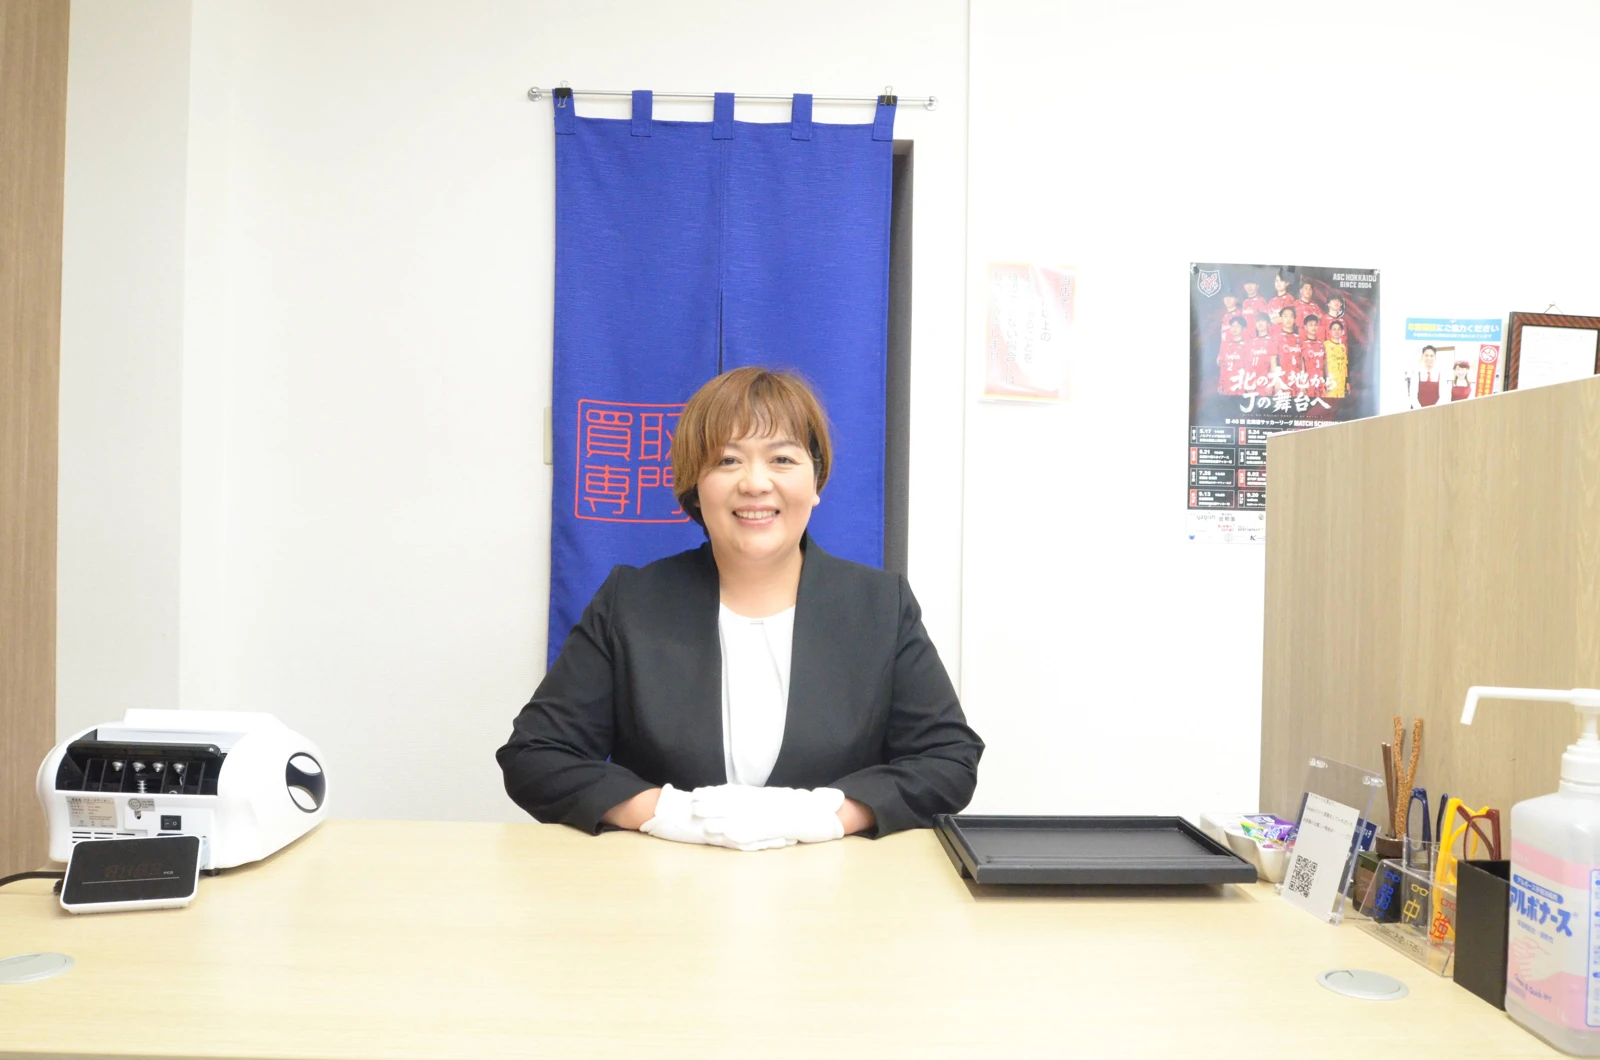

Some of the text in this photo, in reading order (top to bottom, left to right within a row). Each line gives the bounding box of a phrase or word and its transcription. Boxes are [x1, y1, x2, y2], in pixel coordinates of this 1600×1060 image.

[1346, 274, 1376, 282] HOKKAIDO
[1230, 366, 1338, 391] 北の大地から
[1239, 390, 1332, 413] Jの舞台へ
[1403, 899, 1420, 922] 中
[1510, 885, 1573, 937] アルボナース
[1429, 911, 1451, 942] 強
